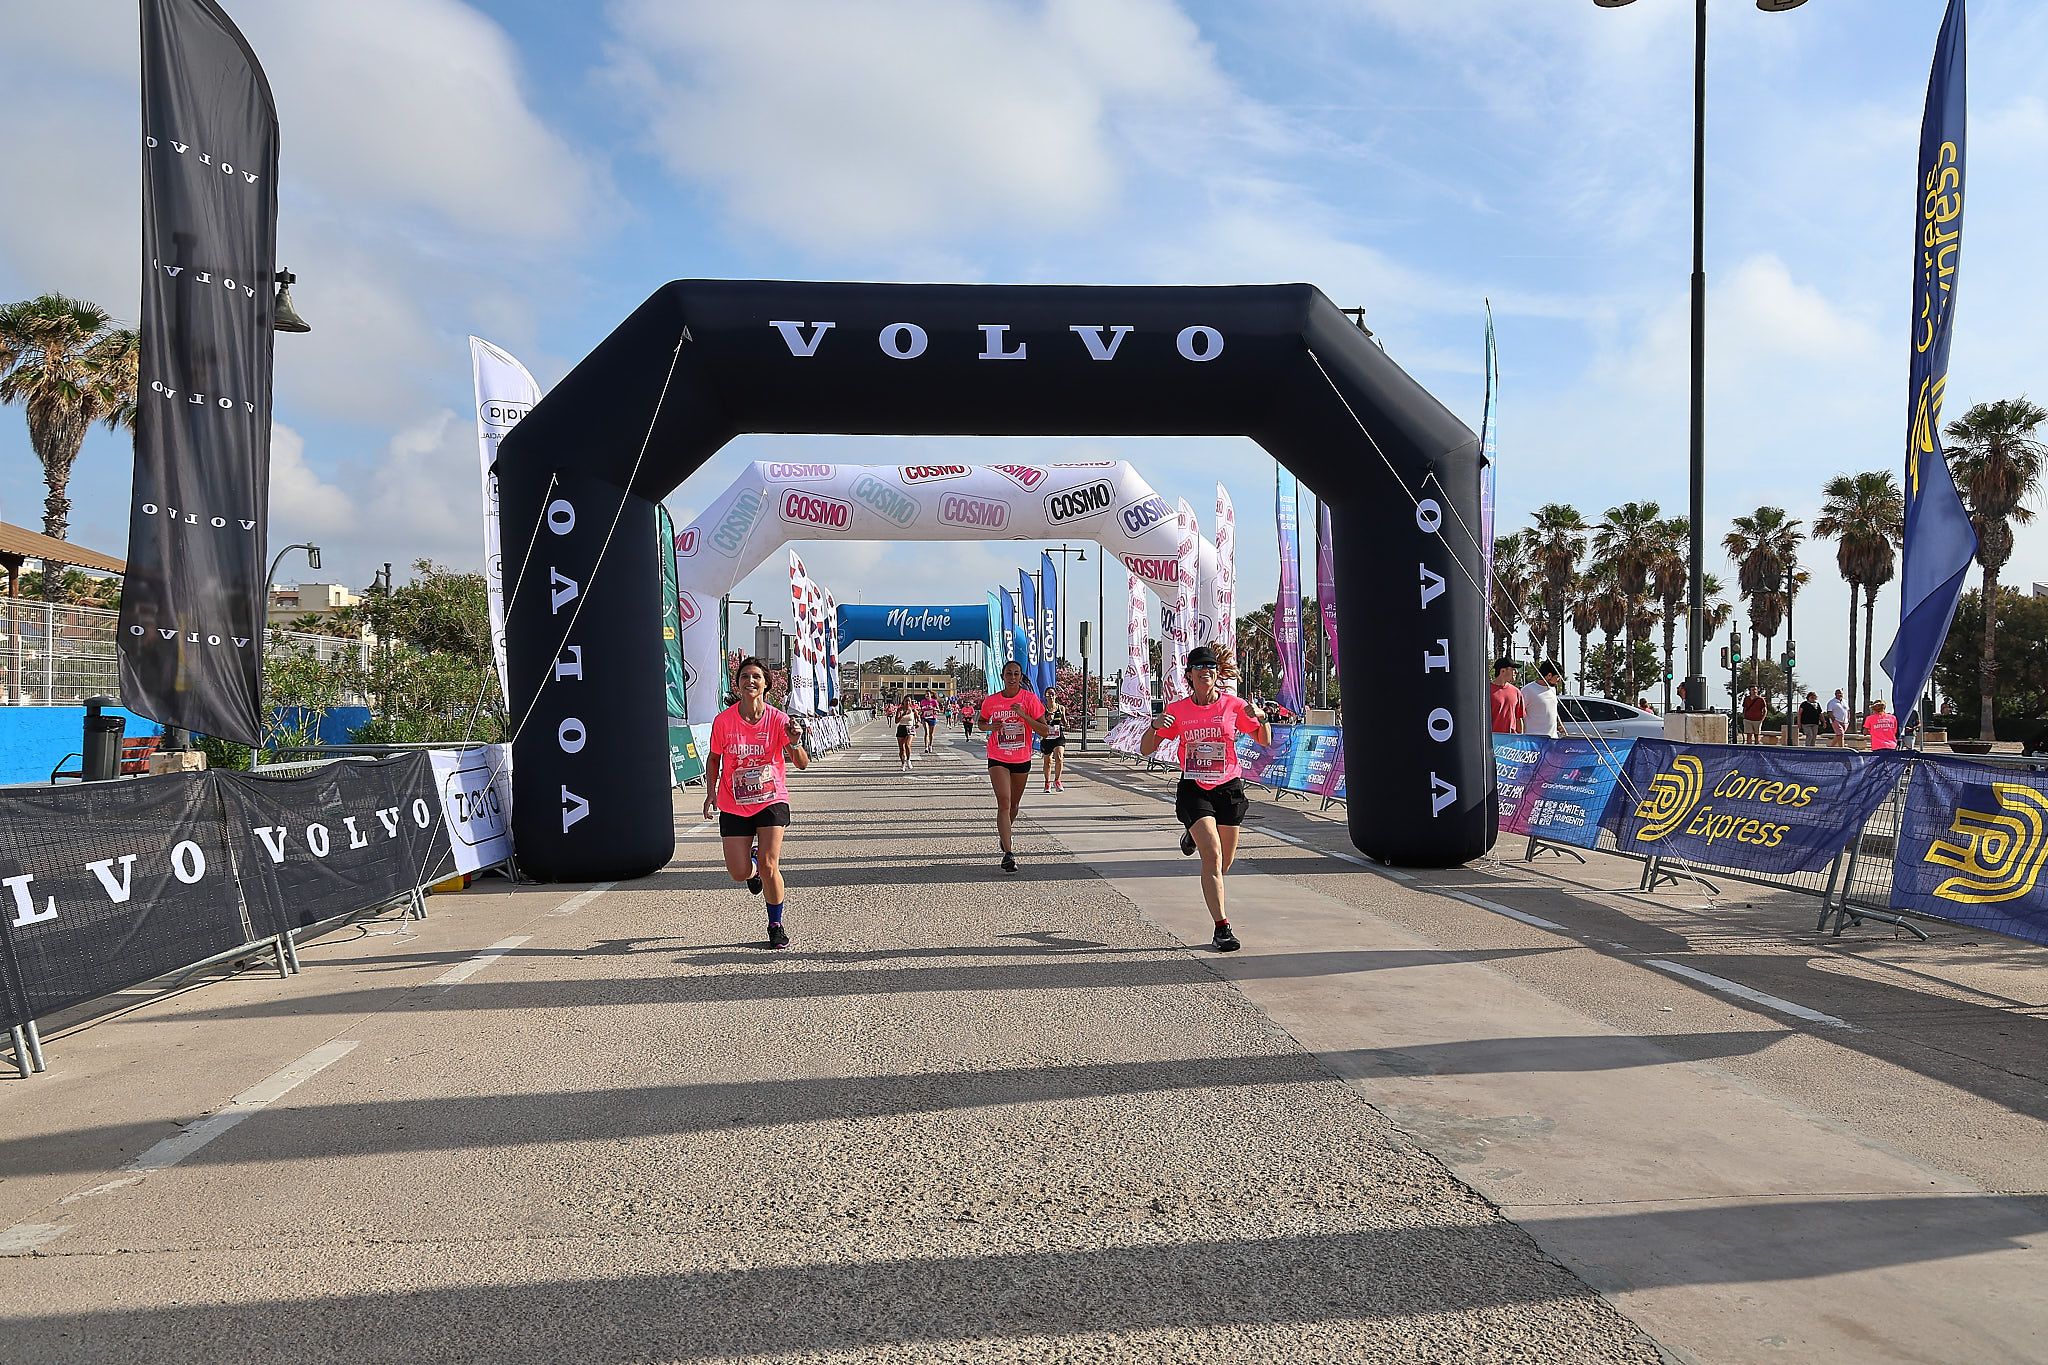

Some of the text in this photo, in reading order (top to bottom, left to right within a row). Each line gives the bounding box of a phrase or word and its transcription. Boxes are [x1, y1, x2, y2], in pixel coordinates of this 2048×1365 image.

[769, 320, 1225, 362] VOLVO
[769, 464, 830, 478] COSMO
[905, 465, 965, 479] COSMO
[785, 493, 848, 528] COSMO
[856, 477, 915, 524] COSMO
[944, 496, 1005, 528] COSMO
[1050, 483, 1111, 521] COSMO
[713, 493, 762, 552] COSMO
[1124, 556, 1179, 582] COSMO
[886, 608, 951, 637] Marlene
[547, 499, 590, 834] VOLVO
[1396, 498, 1457, 818] VOLVO
[1184, 727, 1222, 741] CARRERA
[1713, 769, 1820, 808] Correos
[253, 798, 431, 864] VOLVO
[1686, 805, 1790, 846] Express
[2, 840, 206, 928] LVO
